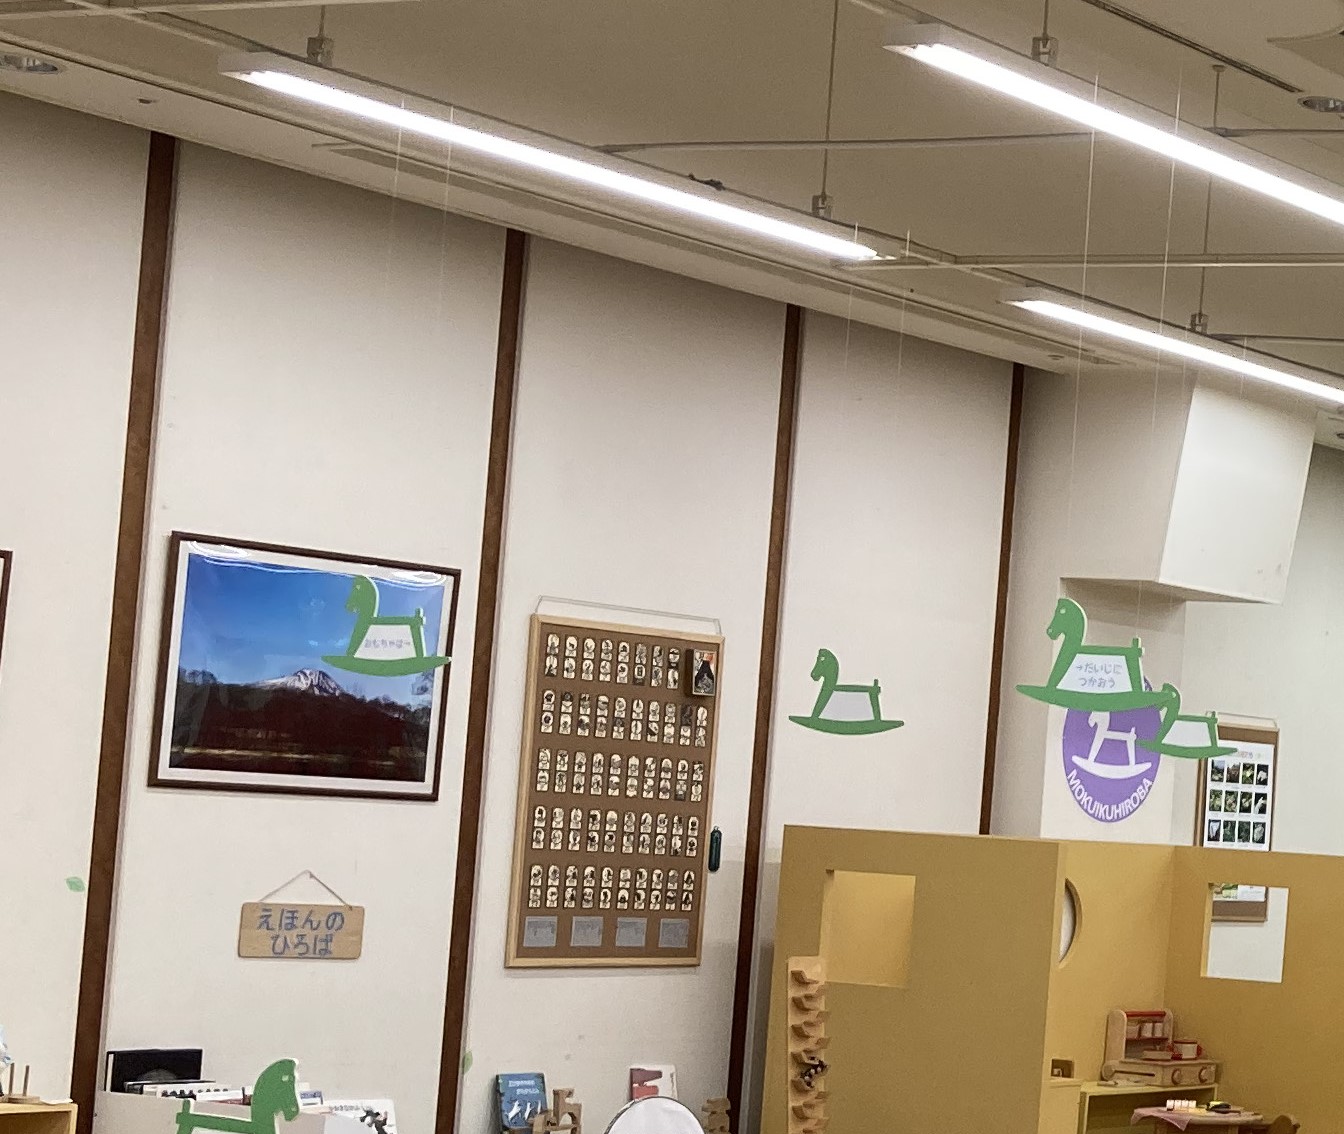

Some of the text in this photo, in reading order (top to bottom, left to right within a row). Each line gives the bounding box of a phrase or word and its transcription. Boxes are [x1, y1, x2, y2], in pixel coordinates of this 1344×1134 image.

[1084, 662, 1123, 675] だいじに
[1078, 676, 1116, 688] つかおう
[257, 907, 345, 932] えほんの
[270, 933, 334, 956] ひろば
